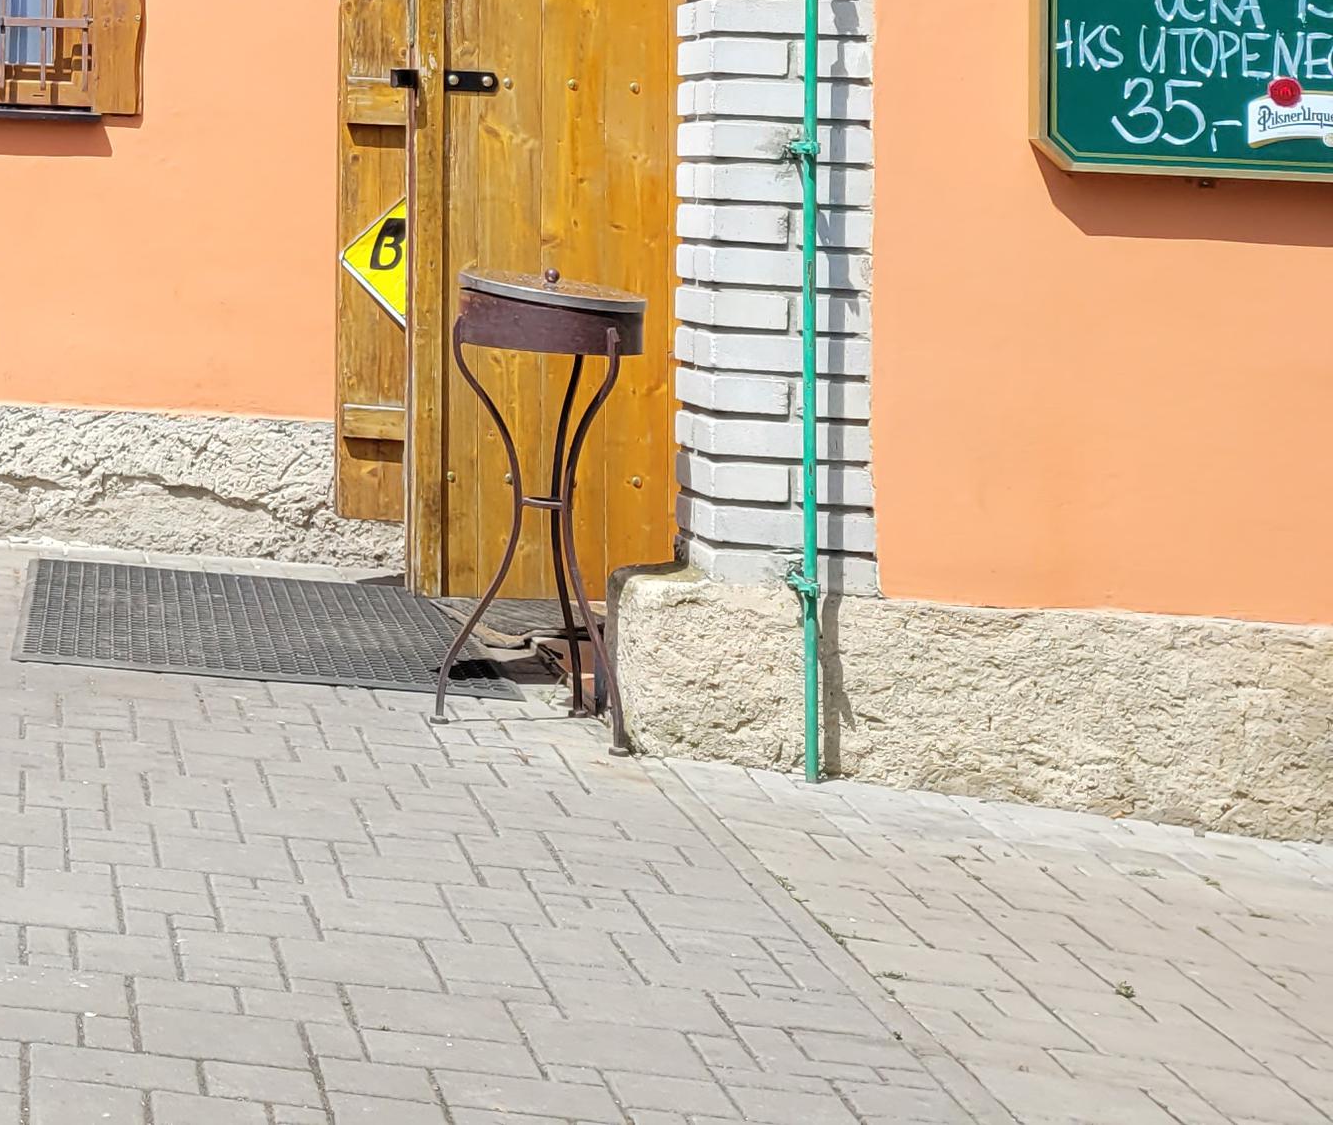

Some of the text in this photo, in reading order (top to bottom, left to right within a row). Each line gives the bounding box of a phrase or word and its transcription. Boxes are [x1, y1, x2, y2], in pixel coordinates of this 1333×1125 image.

[1139, 25, 1333, 81] UTOPENE
[1111, 77, 1243, 153] 35,-
[1257, 104, 1303, 132] Pilsner
